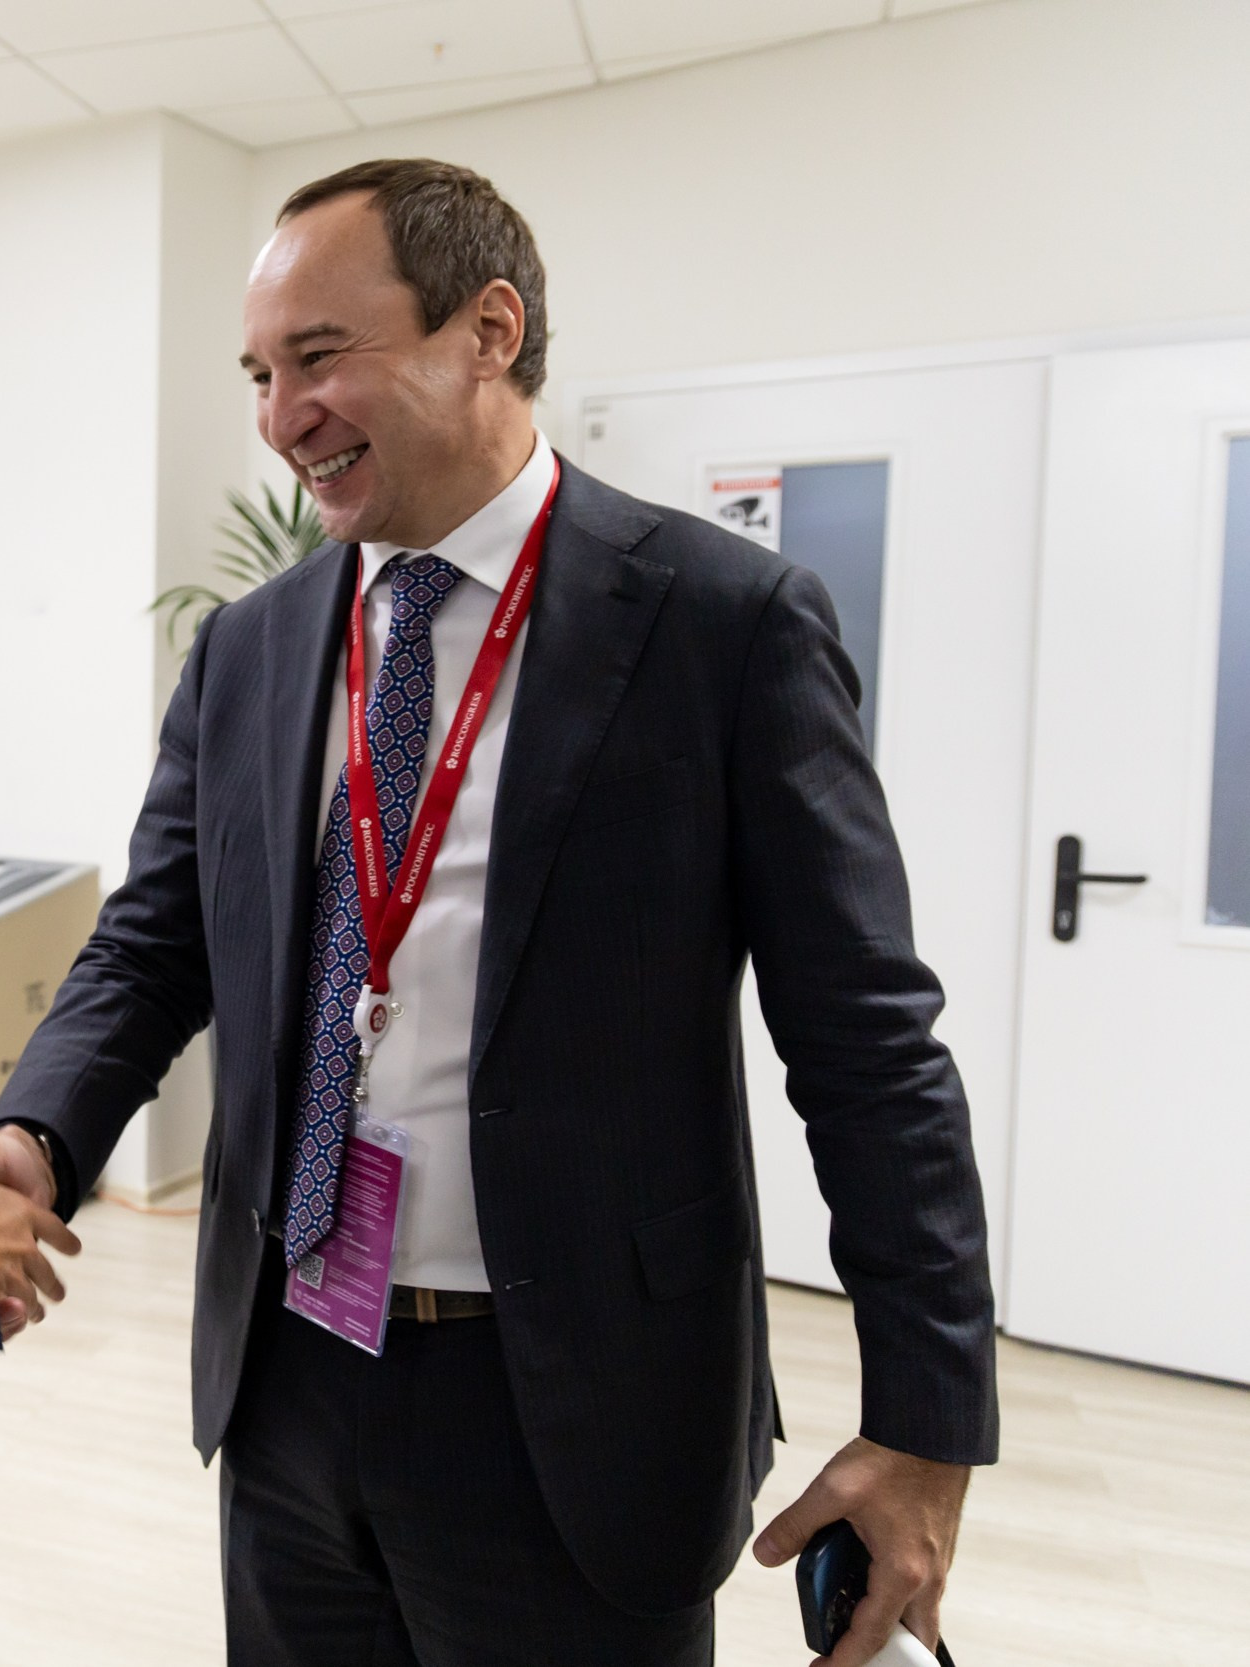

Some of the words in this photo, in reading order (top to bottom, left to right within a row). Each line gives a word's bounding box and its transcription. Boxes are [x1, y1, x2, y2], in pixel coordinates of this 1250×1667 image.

[451, 691, 483, 758] ROSCONGRESS
[362, 829, 379, 898] ROSCONGRESS
[405, 823, 435, 893] РОСКОНГРЕСС
